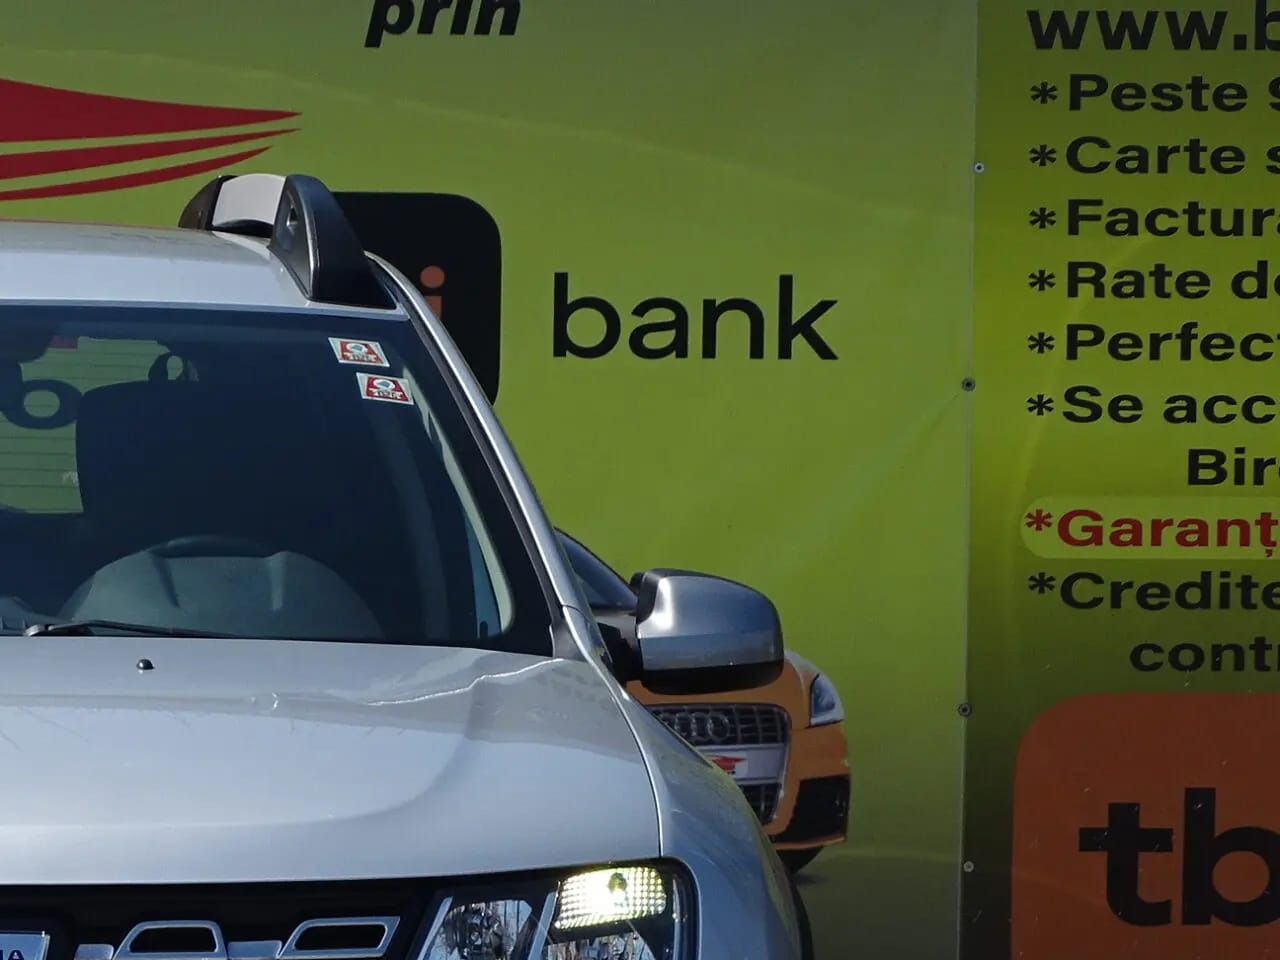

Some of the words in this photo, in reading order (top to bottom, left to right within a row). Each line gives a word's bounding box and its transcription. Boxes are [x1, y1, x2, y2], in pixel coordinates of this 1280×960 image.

[1028, 198, 1280, 237] Factur
[552, 271, 840, 361] bank
[1027, 321, 1280, 361] Perfec
[1186, 446, 1280, 486] Bir
[1129, 635, 1280, 673] cont
